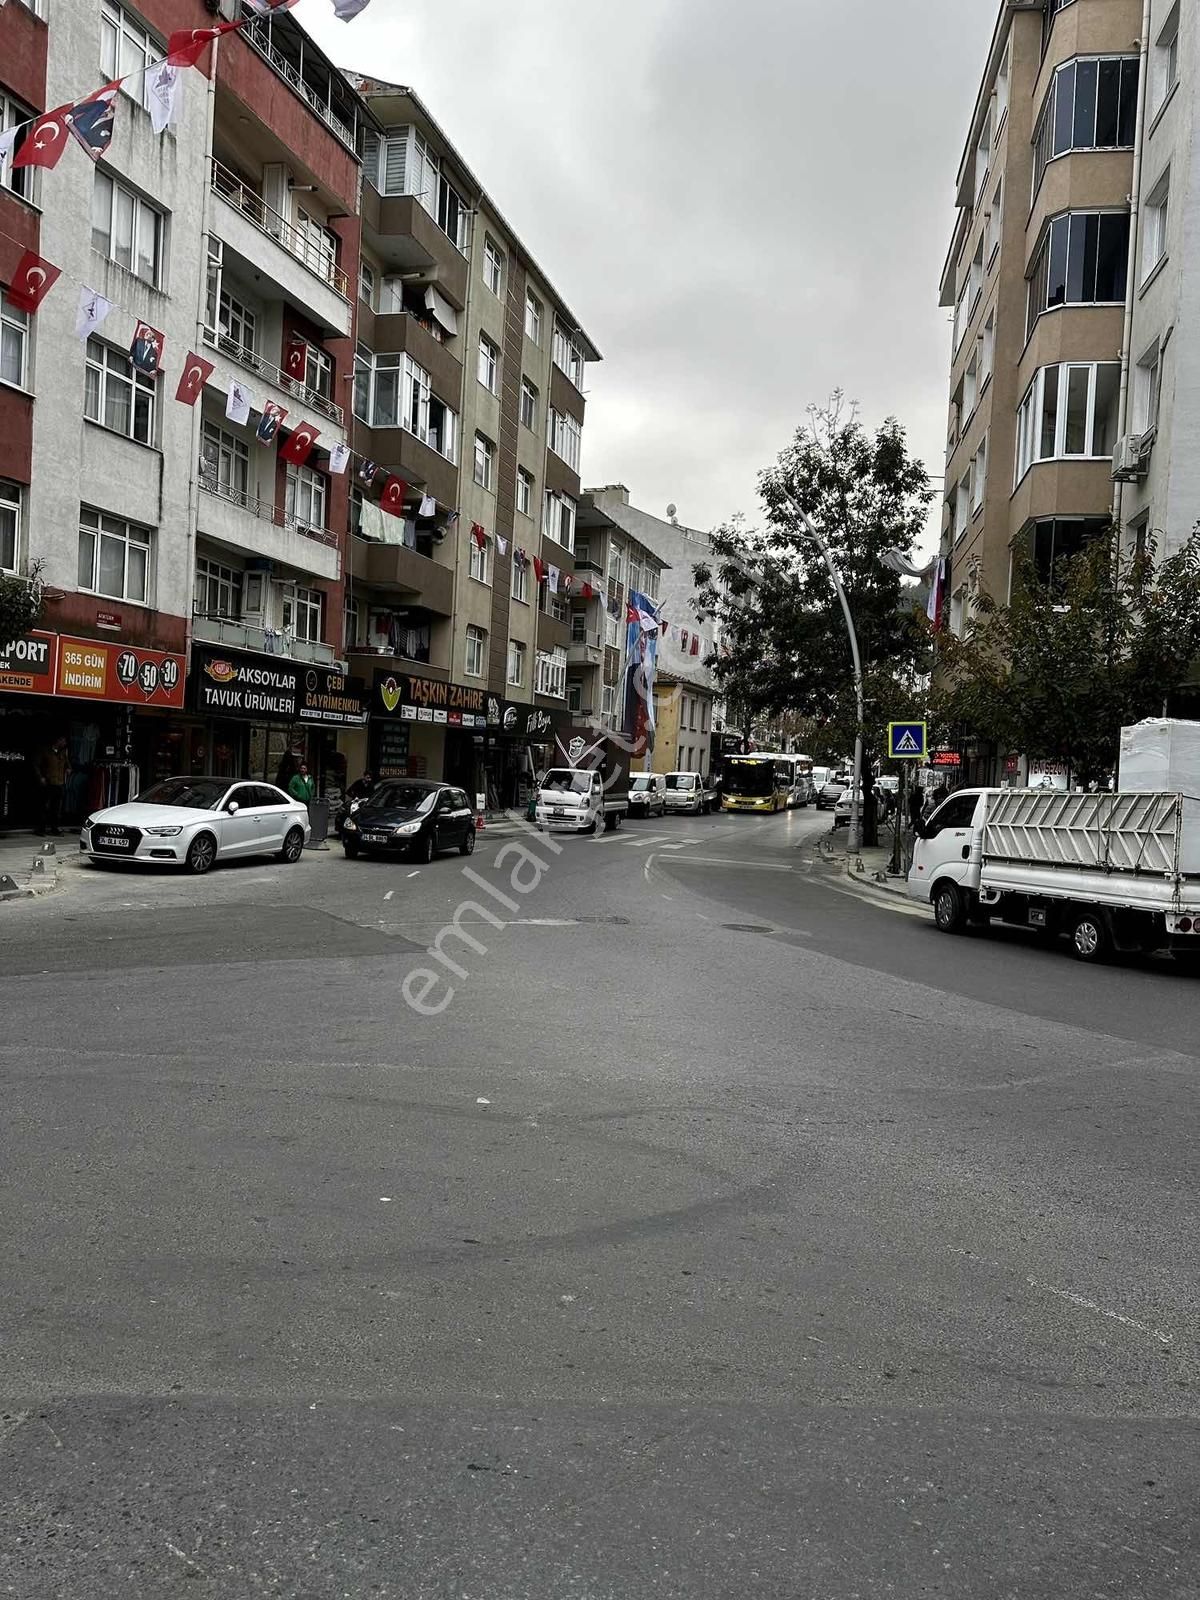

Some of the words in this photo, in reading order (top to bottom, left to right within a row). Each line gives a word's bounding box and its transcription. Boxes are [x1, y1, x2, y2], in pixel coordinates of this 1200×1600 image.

[0, 640, 48, 662] PORT
[64, 651, 82, 666] 365
[84, 653, 105, 669] GÜN
[65, 672, 102, 689] İNDİRİM
[237, 667, 296, 690] AKSOYLAR
[326, 672, 345, 691] ÇEBİ
[204, 688, 242, 708] TAVUK
[244, 690, 296, 714] ÜRÜNLERİ
[305, 692, 361, 713] GAYRİMENKUL
[409, 677, 448, 707] TAŞKIN
